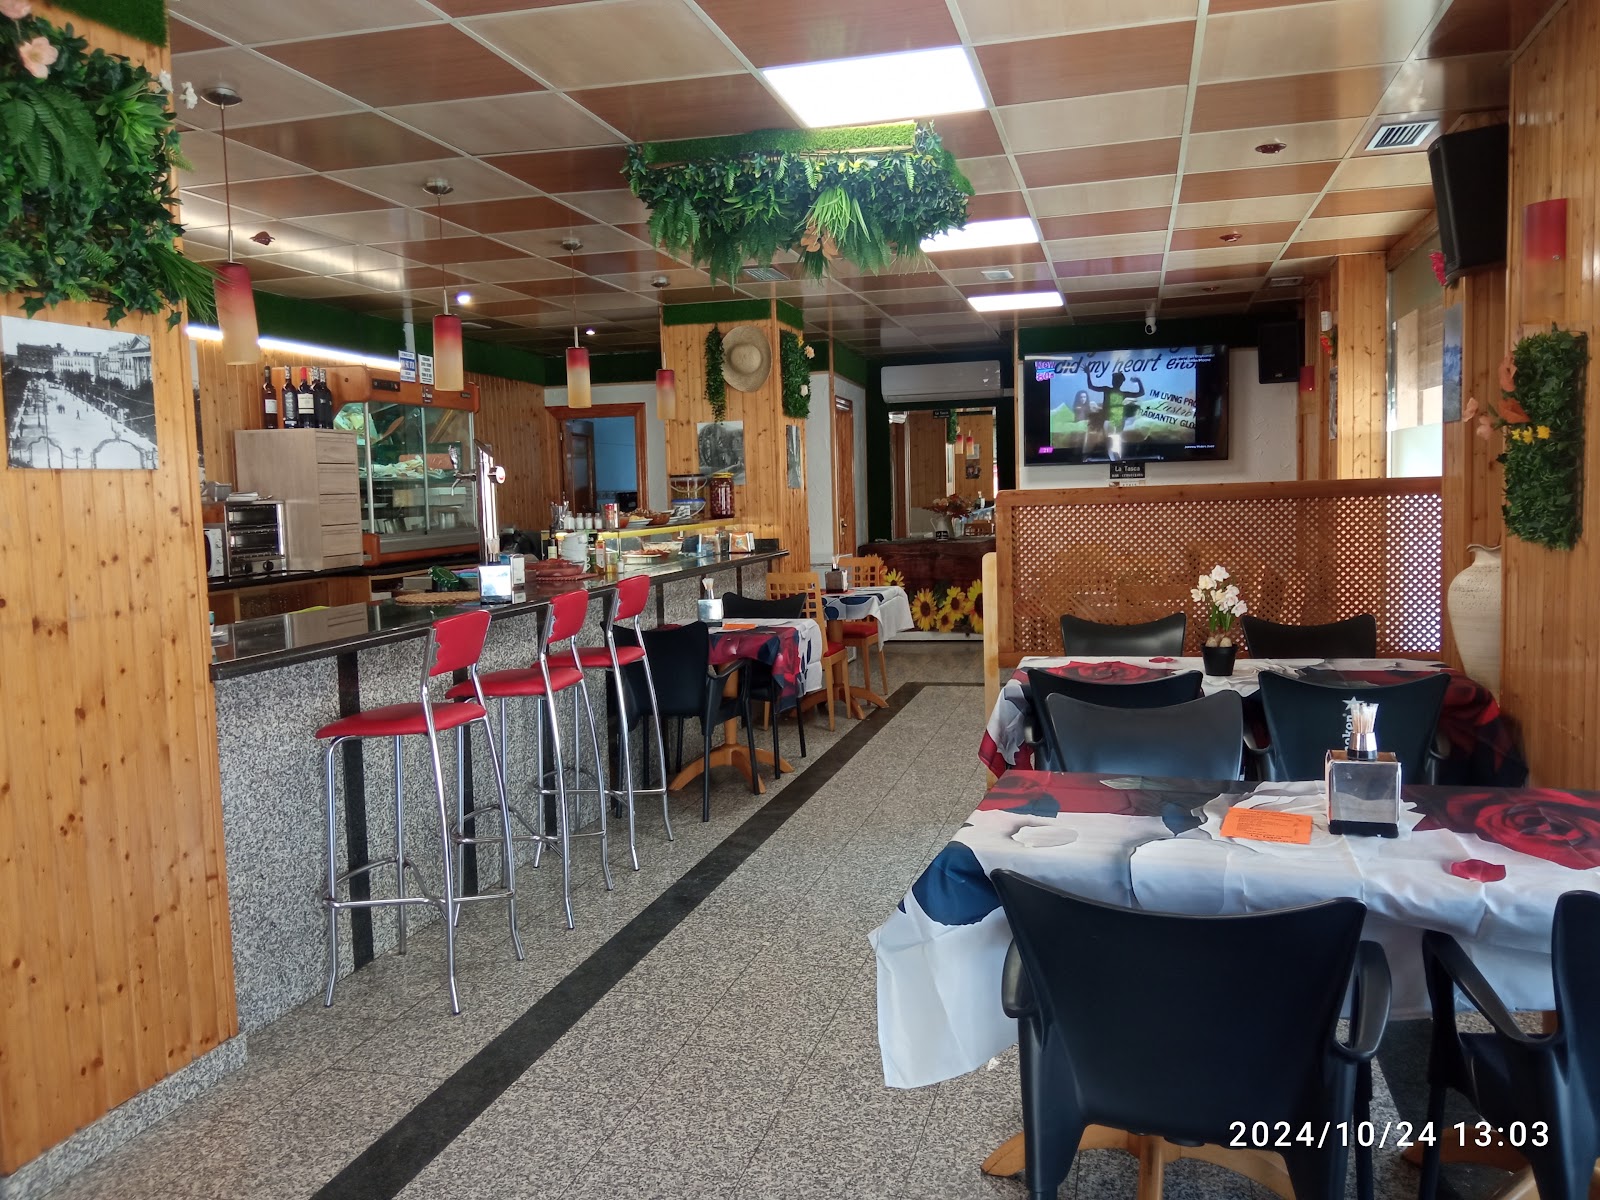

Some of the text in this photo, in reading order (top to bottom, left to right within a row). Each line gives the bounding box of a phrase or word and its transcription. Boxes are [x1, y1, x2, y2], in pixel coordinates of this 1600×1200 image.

[1087, 359, 1109, 379] my
[1112, 353, 1161, 373] heart
[1161, 391, 1182, 404] LIVING
[1139, 409, 1196, 429] RADIANTLY GLO
